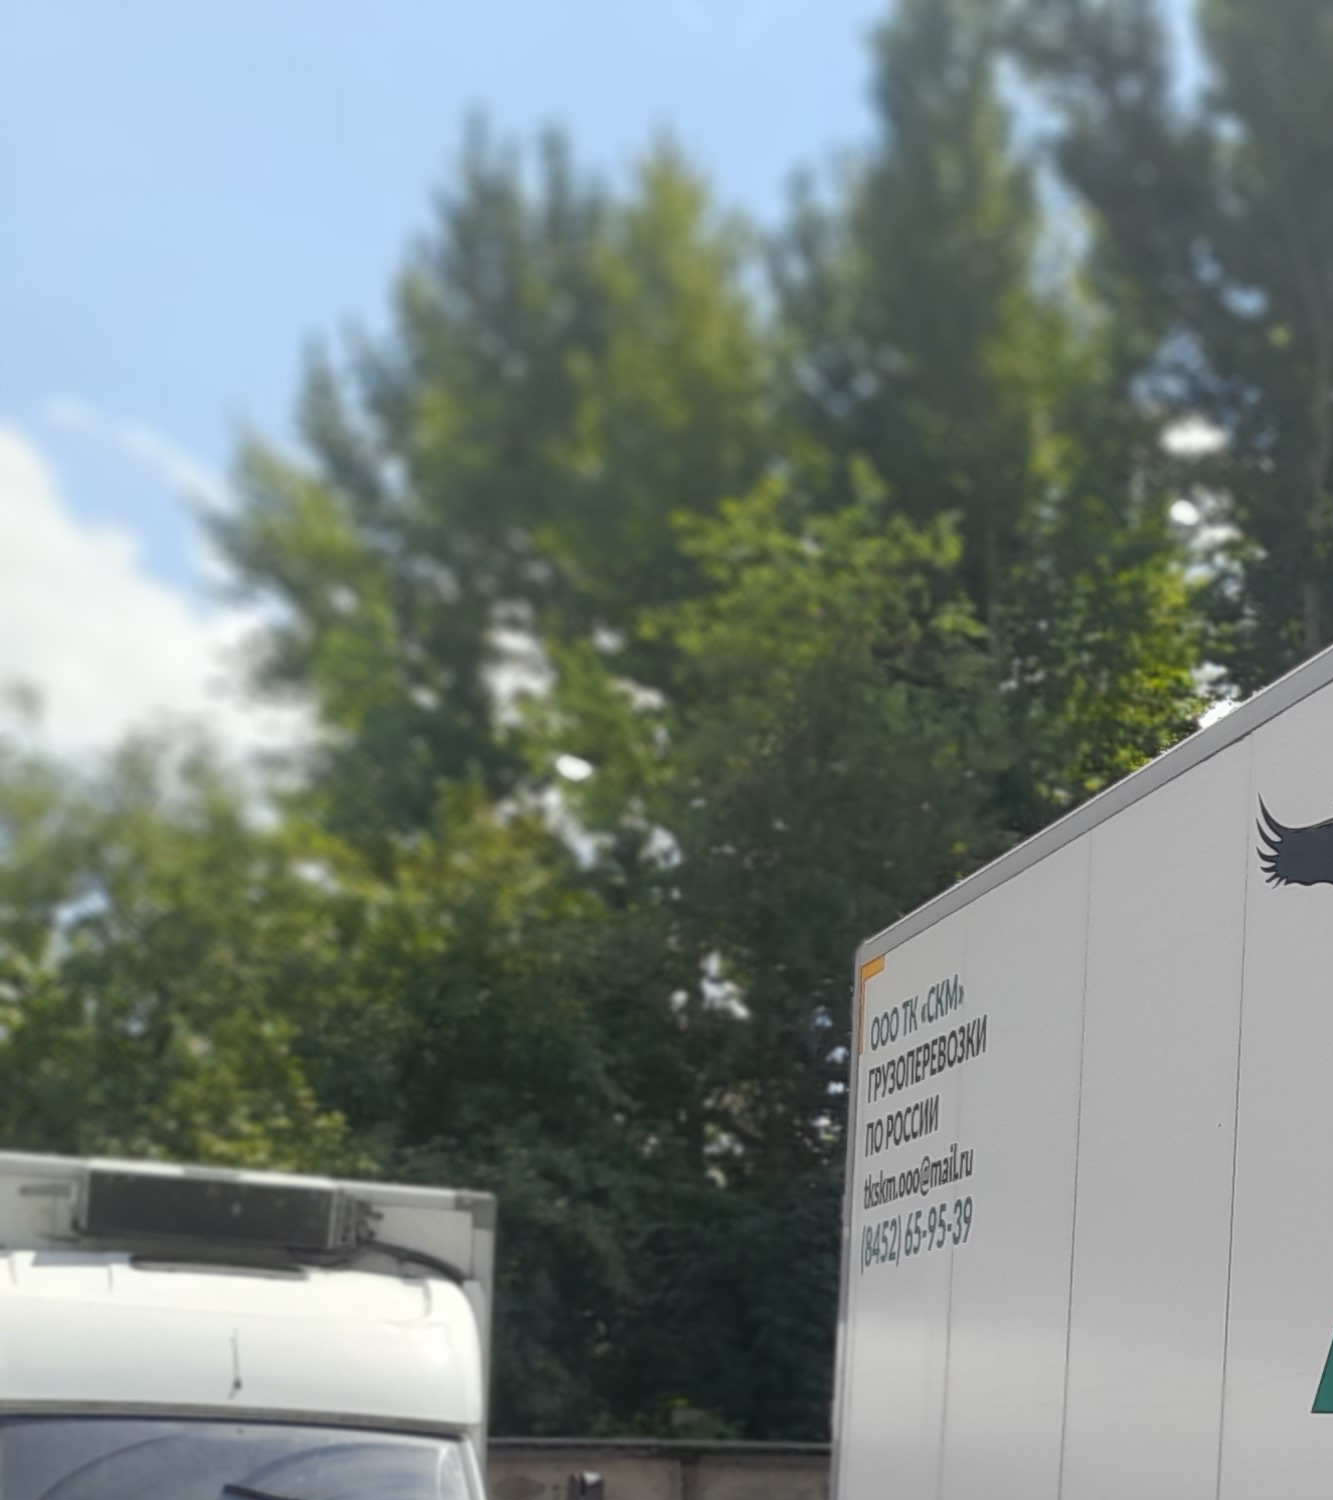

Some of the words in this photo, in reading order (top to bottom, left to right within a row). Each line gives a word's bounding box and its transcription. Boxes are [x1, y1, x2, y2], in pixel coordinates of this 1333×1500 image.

[871, 1006, 899, 1051] ООО
[902, 995, 919, 1036] ТК
[921, 973, 964, 1023] «СКМ»
[867, 1014, 987, 1104] ГРУЗОПЕРЕВОЗКИ
[865, 1119, 883, 1157] ПО
[885, 1094, 939, 1150] РОССИИ
[864, 1142, 974, 1210] tkskm.ooo@mail.ru
[860, 1214, 901, 1275] (8452)
[904, 1196, 973, 1256] 65-95-39
